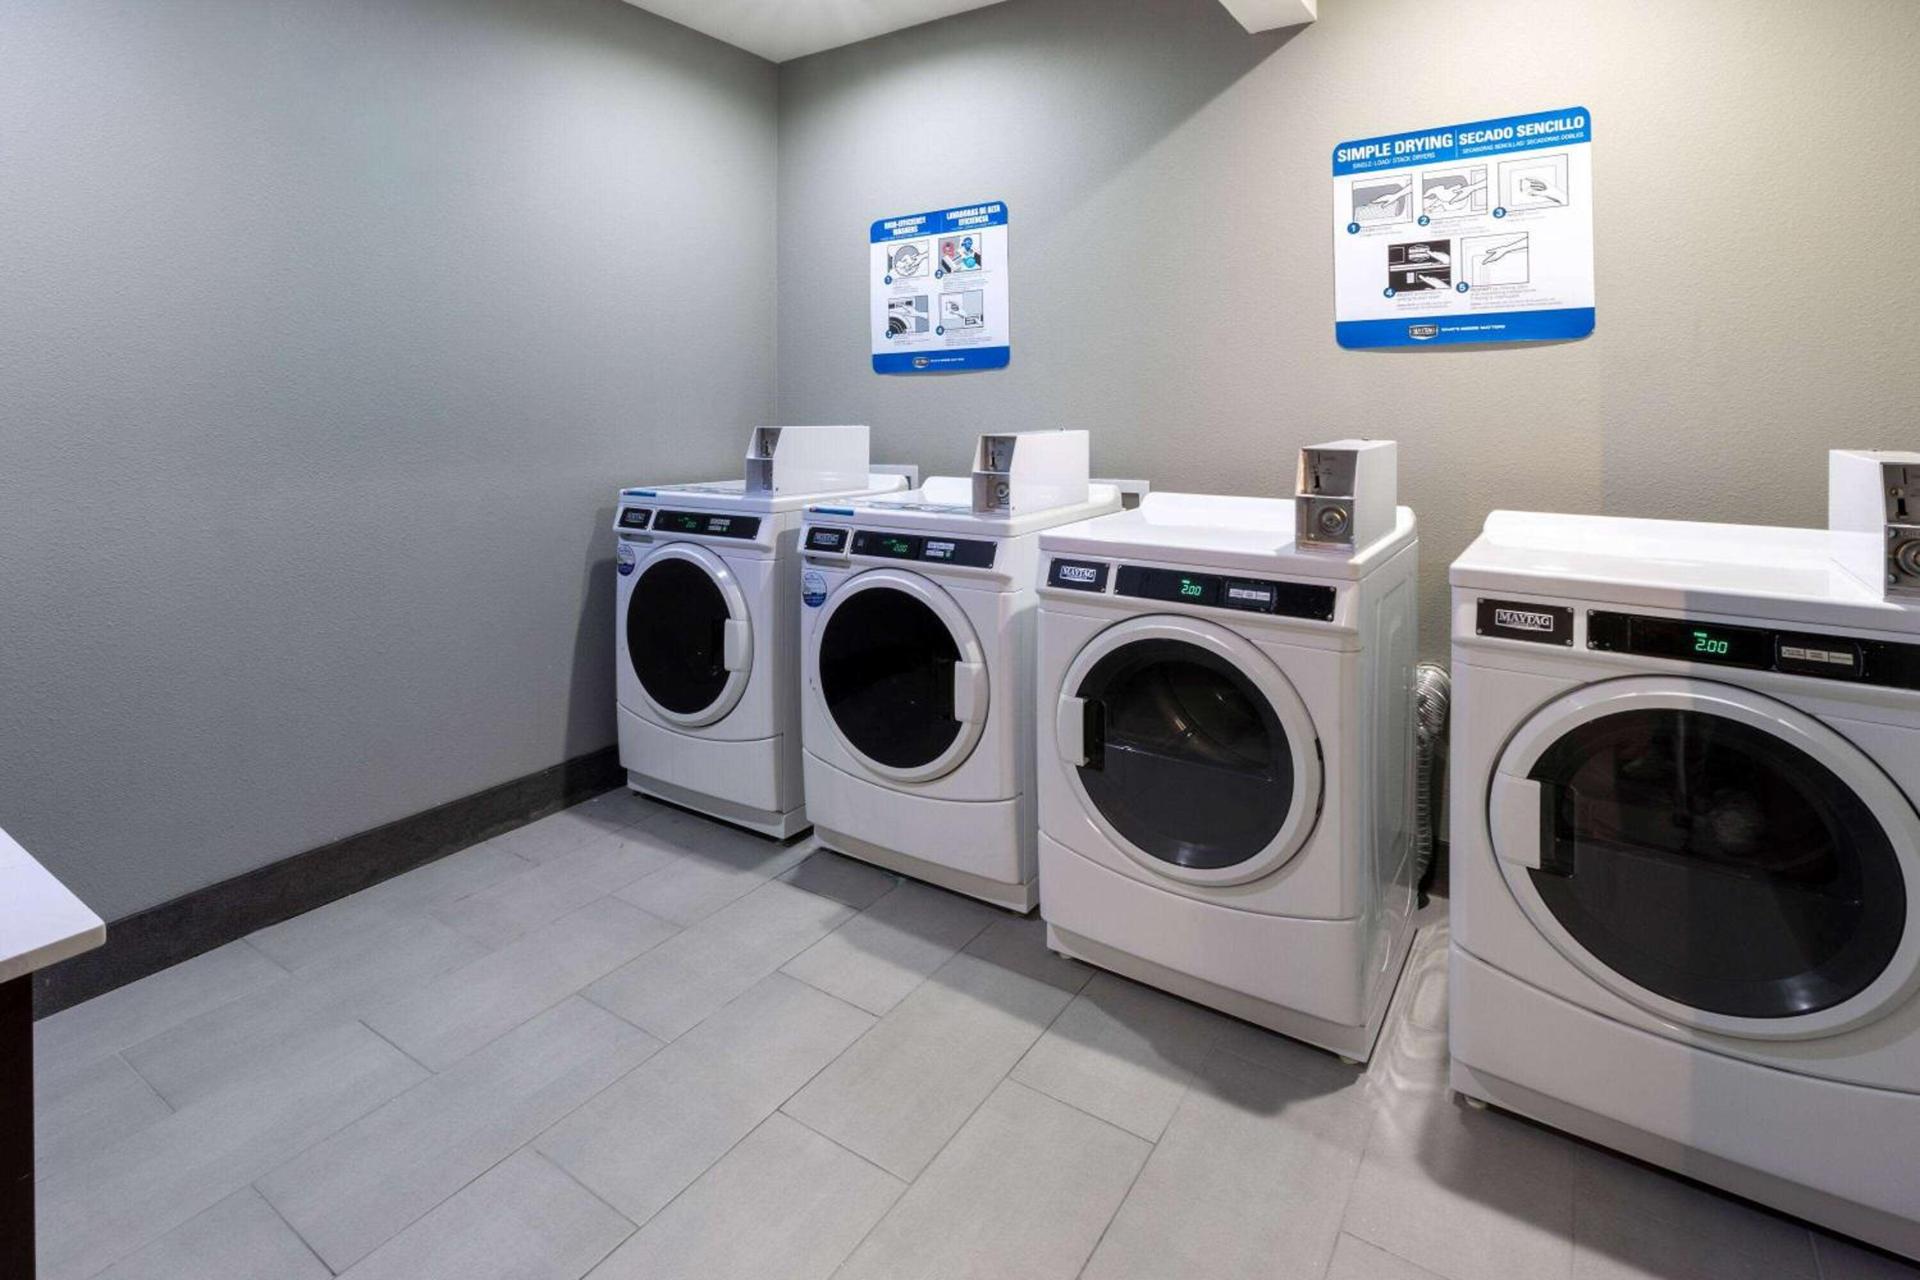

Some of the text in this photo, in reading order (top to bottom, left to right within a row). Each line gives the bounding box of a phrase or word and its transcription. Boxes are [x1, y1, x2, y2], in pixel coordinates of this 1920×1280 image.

[1459, 115, 1585, 146] SECADO SENCILLO
[1337, 133, 1454, 162] SIMPLE DRYING
[1181, 584, 1201, 596] 2.00
[1498, 610, 1550, 626] MAYTAG
[1695, 637, 1728, 655] 2.00
